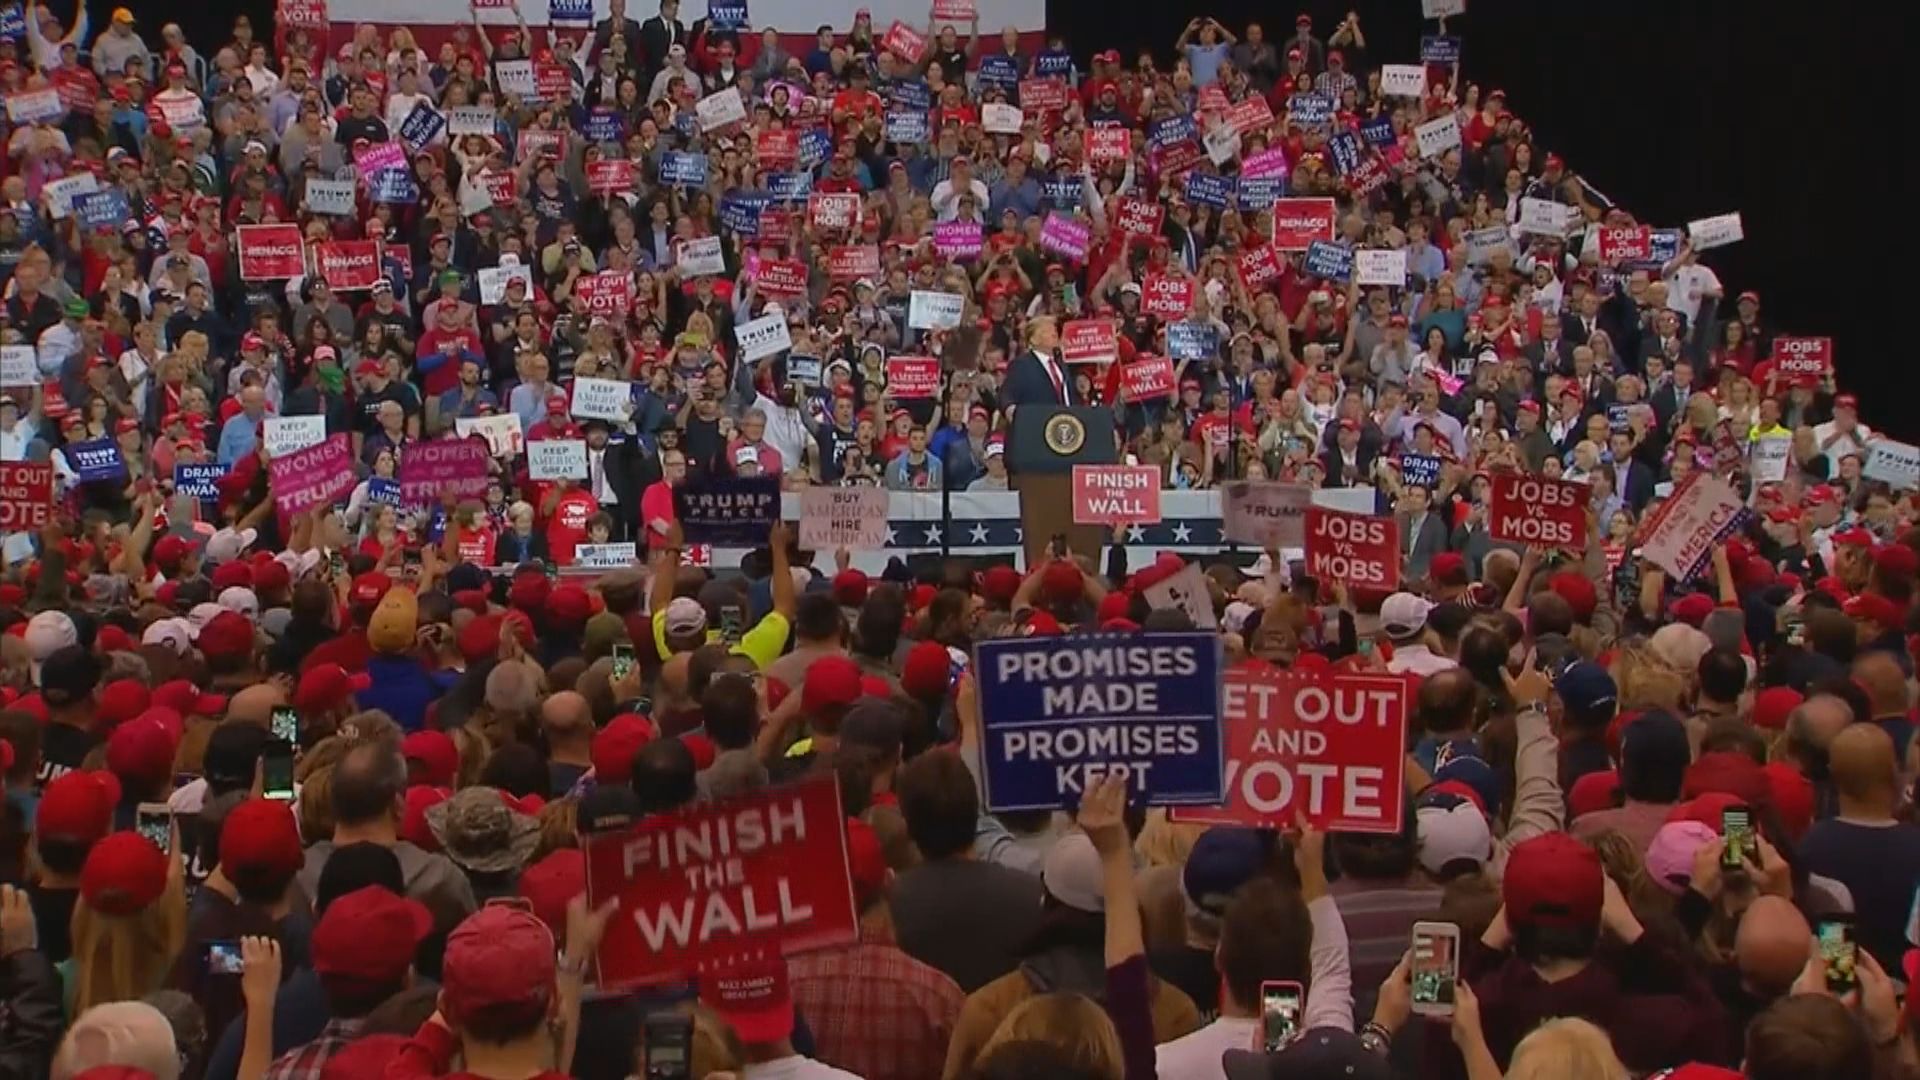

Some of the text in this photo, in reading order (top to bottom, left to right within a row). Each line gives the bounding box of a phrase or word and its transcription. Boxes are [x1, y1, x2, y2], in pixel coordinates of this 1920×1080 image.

[283, 10, 320, 22] VOTE
[1296, 100, 1328, 108] DRAIN
[1092, 131, 1123, 141] JOBS
[1421, 124, 1454, 140] TRUMP
[1242, 150, 1282, 168] WOMEN
[662, 163, 705, 174] AMERICA
[311, 188, 351, 198] TRUMP
[816, 197, 850, 210] JOBS
[1122, 200, 1158, 217] JOBS
[814, 214, 850, 226] MOBS
[1118, 218, 1153, 234] MOBS
[1280, 218, 1328, 228] RENACCI
[937, 226, 982, 234] WOMEN
[1052, 216, 1089, 240] WOMEN
[1606, 229, 1642, 240] JOBS
[938, 244, 982, 254] TRUMP
[1042, 233, 1084, 256] TRUMP
[248, 246, 297, 256] RENACCI
[1606, 247, 1643, 257] MOBS
[323, 254, 372, 266] RENACCI
[1241, 248, 1270, 268] JOBS
[758, 271, 806, 283] AMERICA
[1246, 264, 1276, 285] MOBS
[578, 276, 626, 290] GET OUT
[1150, 280, 1187, 292] JOBS
[582, 296, 626, 308] VOTE
[1148, 300, 1185, 312] MOBS
[742, 323, 783, 341] TRUMP
[1064, 335, 1113, 346] AMERICA
[1781, 341, 1822, 352] JOBS
[1127, 362, 1166, 376] FINISH
[1780, 360, 1822, 371] MOBS
[892, 372, 938, 382] AMERICA
[590, 384, 616, 392] KEEP
[1130, 380, 1168, 392] WALL
[578, 392, 620, 402] AMERIC
[584, 403, 617, 414] GREAT
[280, 423, 308, 432] KEEP
[266, 432, 322, 443] AMERICA
[76, 448, 116, 460] TRUMP
[406, 445, 486, 465] WOMEN
[543, 447, 570, 455] KEEP
[273, 438, 348, 478] WOMEN
[532, 456, 584, 465] AMERICA
[16, 468, 50, 484] OUT
[184, 468, 224, 478] DRAIN
[542, 466, 574, 474] GREAT
[1085, 472, 1148, 488] FINISH
[278, 470, 353, 511] TRUMP
[401, 476, 486, 498] TRUMP
[834, 493, 860, 503] BUY
[1106, 489, 1126, 498] THE
[1504, 480, 1576, 507] JOBS
[684, 493, 772, 508] TRUMP
[1088, 499, 1146, 514] WALL
[0, 502, 46, 524] OTE
[692, 507, 764, 518] PENCE
[806, 504, 884, 519] AMERICAN
[1526, 504, 1548, 518] VS.
[832, 520, 862, 531] HIRE
[1315, 514, 1385, 544] JOBS
[1502, 516, 1574, 542] MOBS
[806, 532, 880, 544] AMERICAN
[1674, 502, 1734, 572] AMERICA
[1334, 542, 1357, 556] VS.
[1314, 552, 1384, 582] MOBS
[996, 646, 1198, 682] PROMISES
[1042, 682, 1158, 716] MADE
[1222, 684, 1398, 727] ET OUT
[1002, 724, 1200, 762] PROMISES
[1250, 727, 1328, 756] AND
[623, 797, 807, 880] FINISH
[685, 858, 744, 892] THE
[633, 876, 813, 952] WALL
[742, 976, 774, 988] AMERICA
